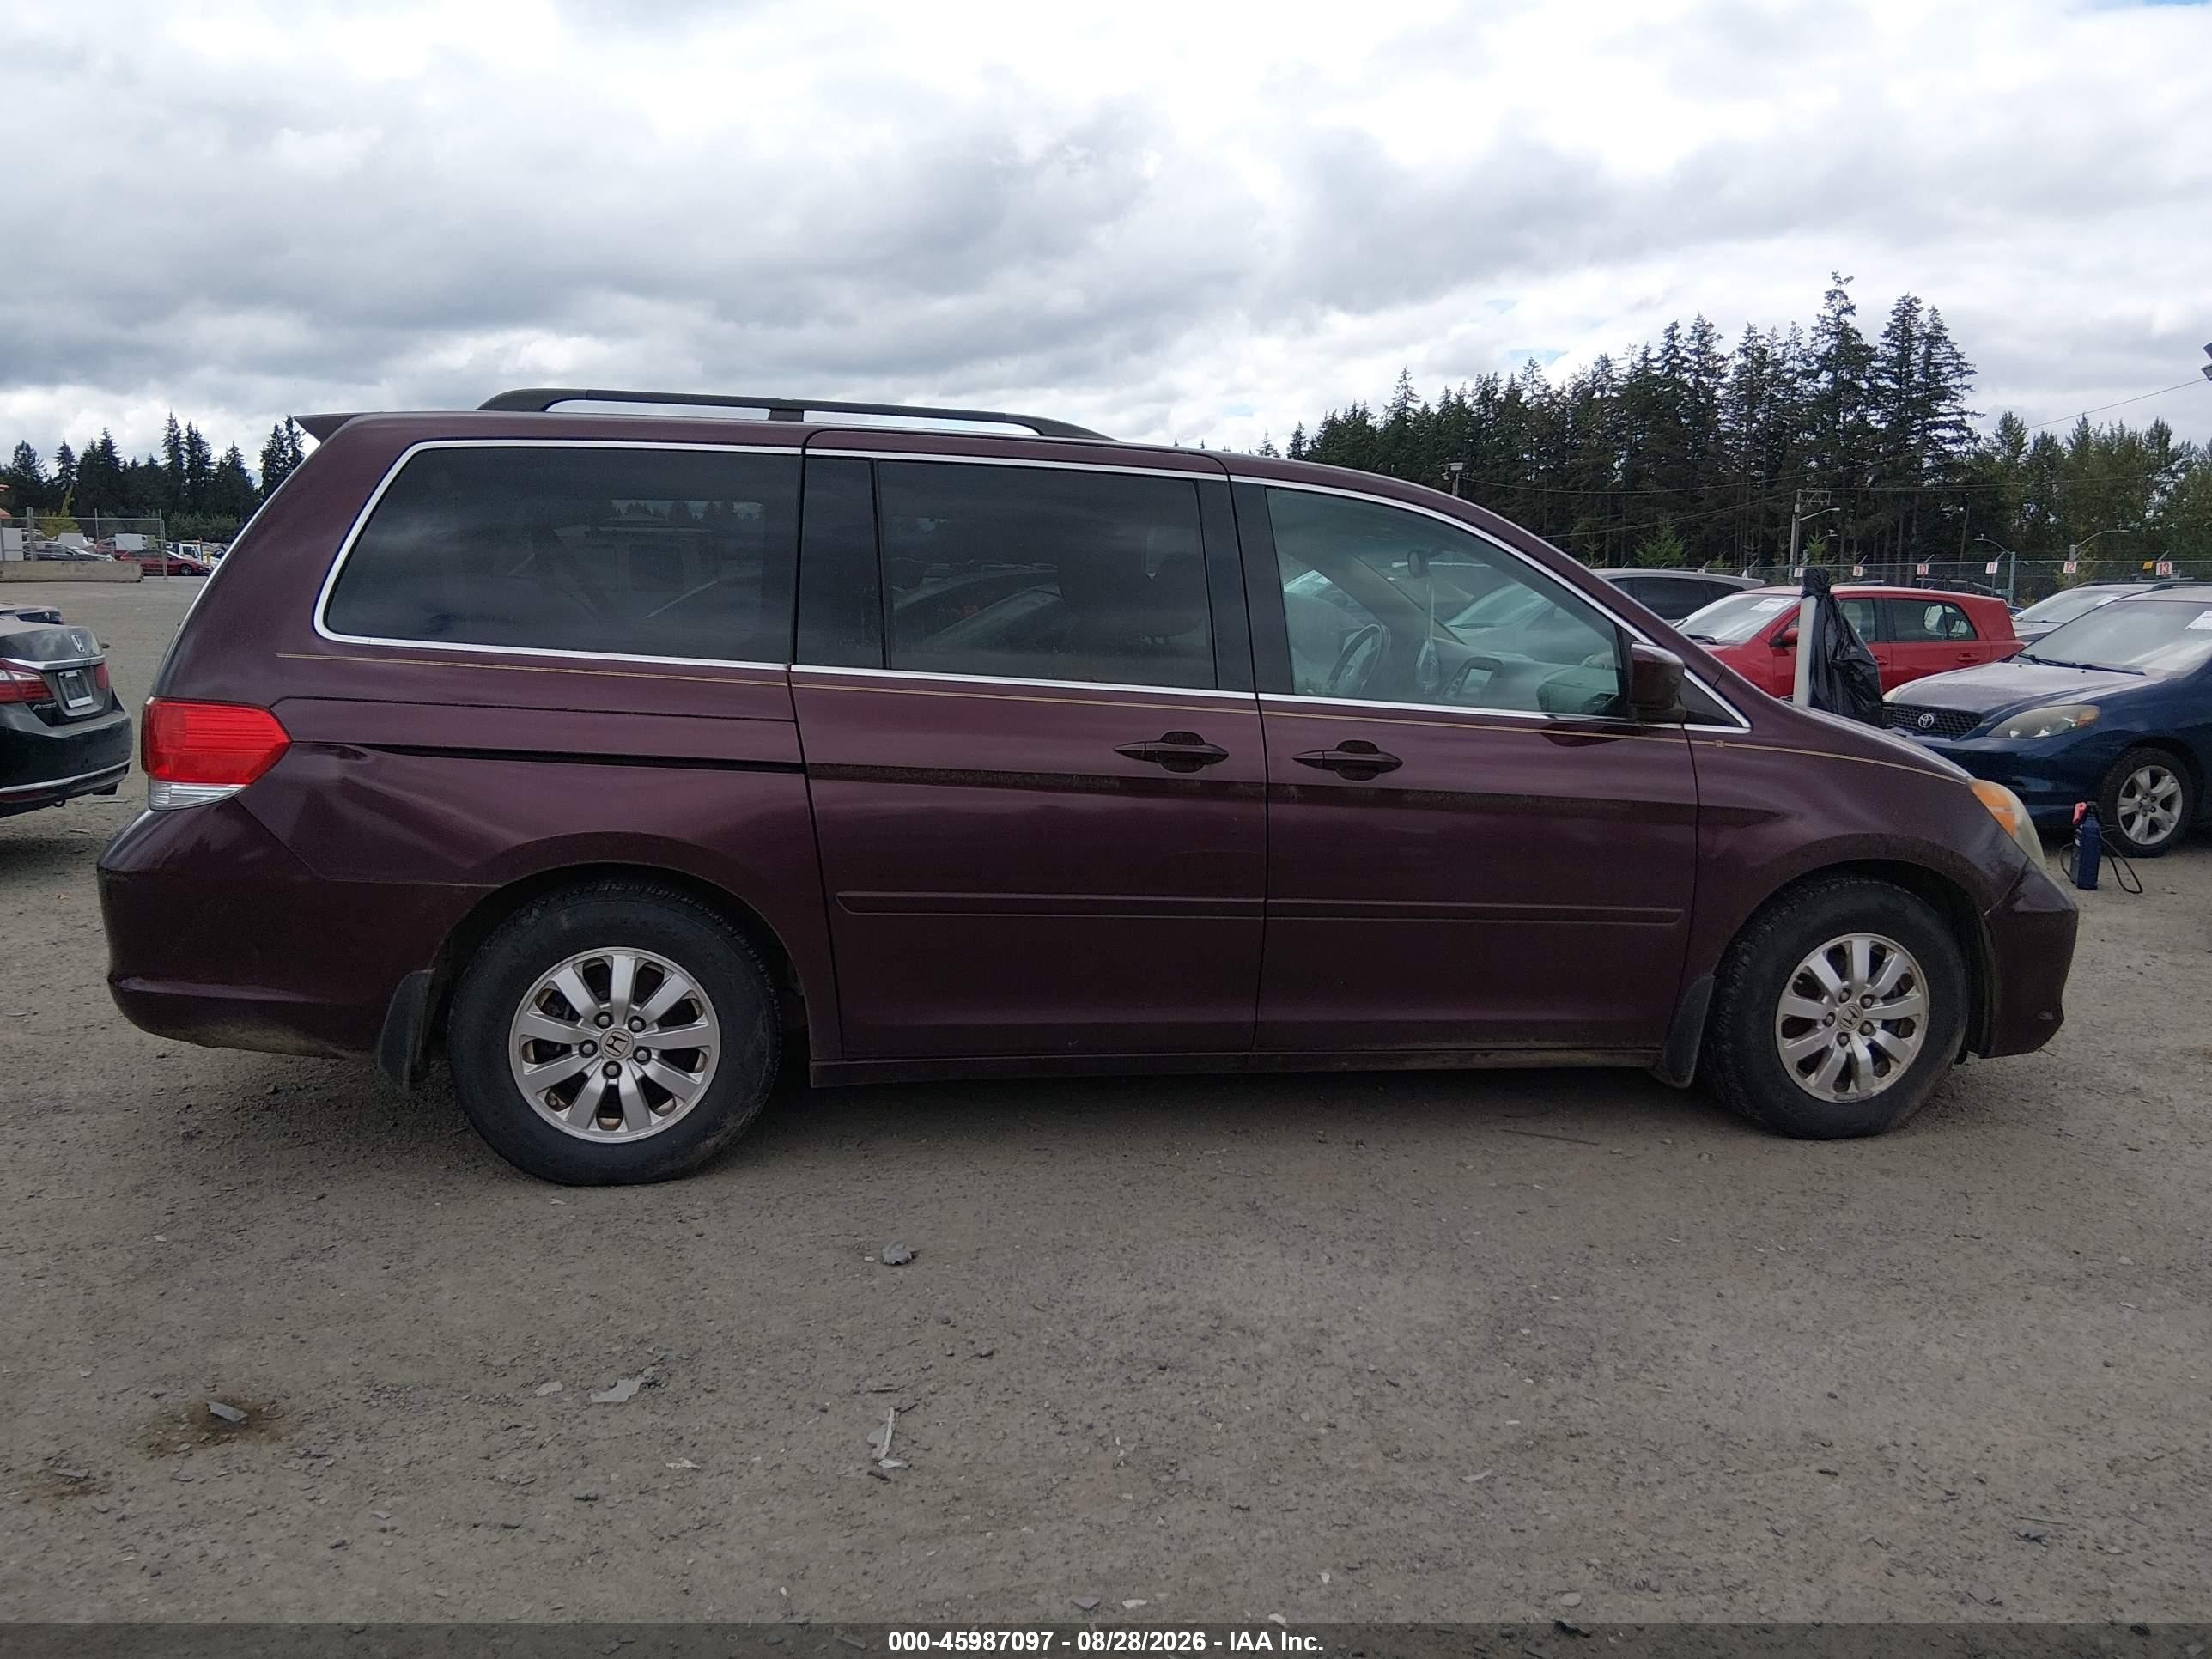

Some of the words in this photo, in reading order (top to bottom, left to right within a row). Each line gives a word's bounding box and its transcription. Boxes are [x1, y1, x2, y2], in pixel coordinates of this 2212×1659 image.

[1919, 564, 1927, 574] 10
[1989, 562, 1996, 573] 11
[2066, 562, 2075, 573] 12
[2159, 562, 2170, 574] 13
